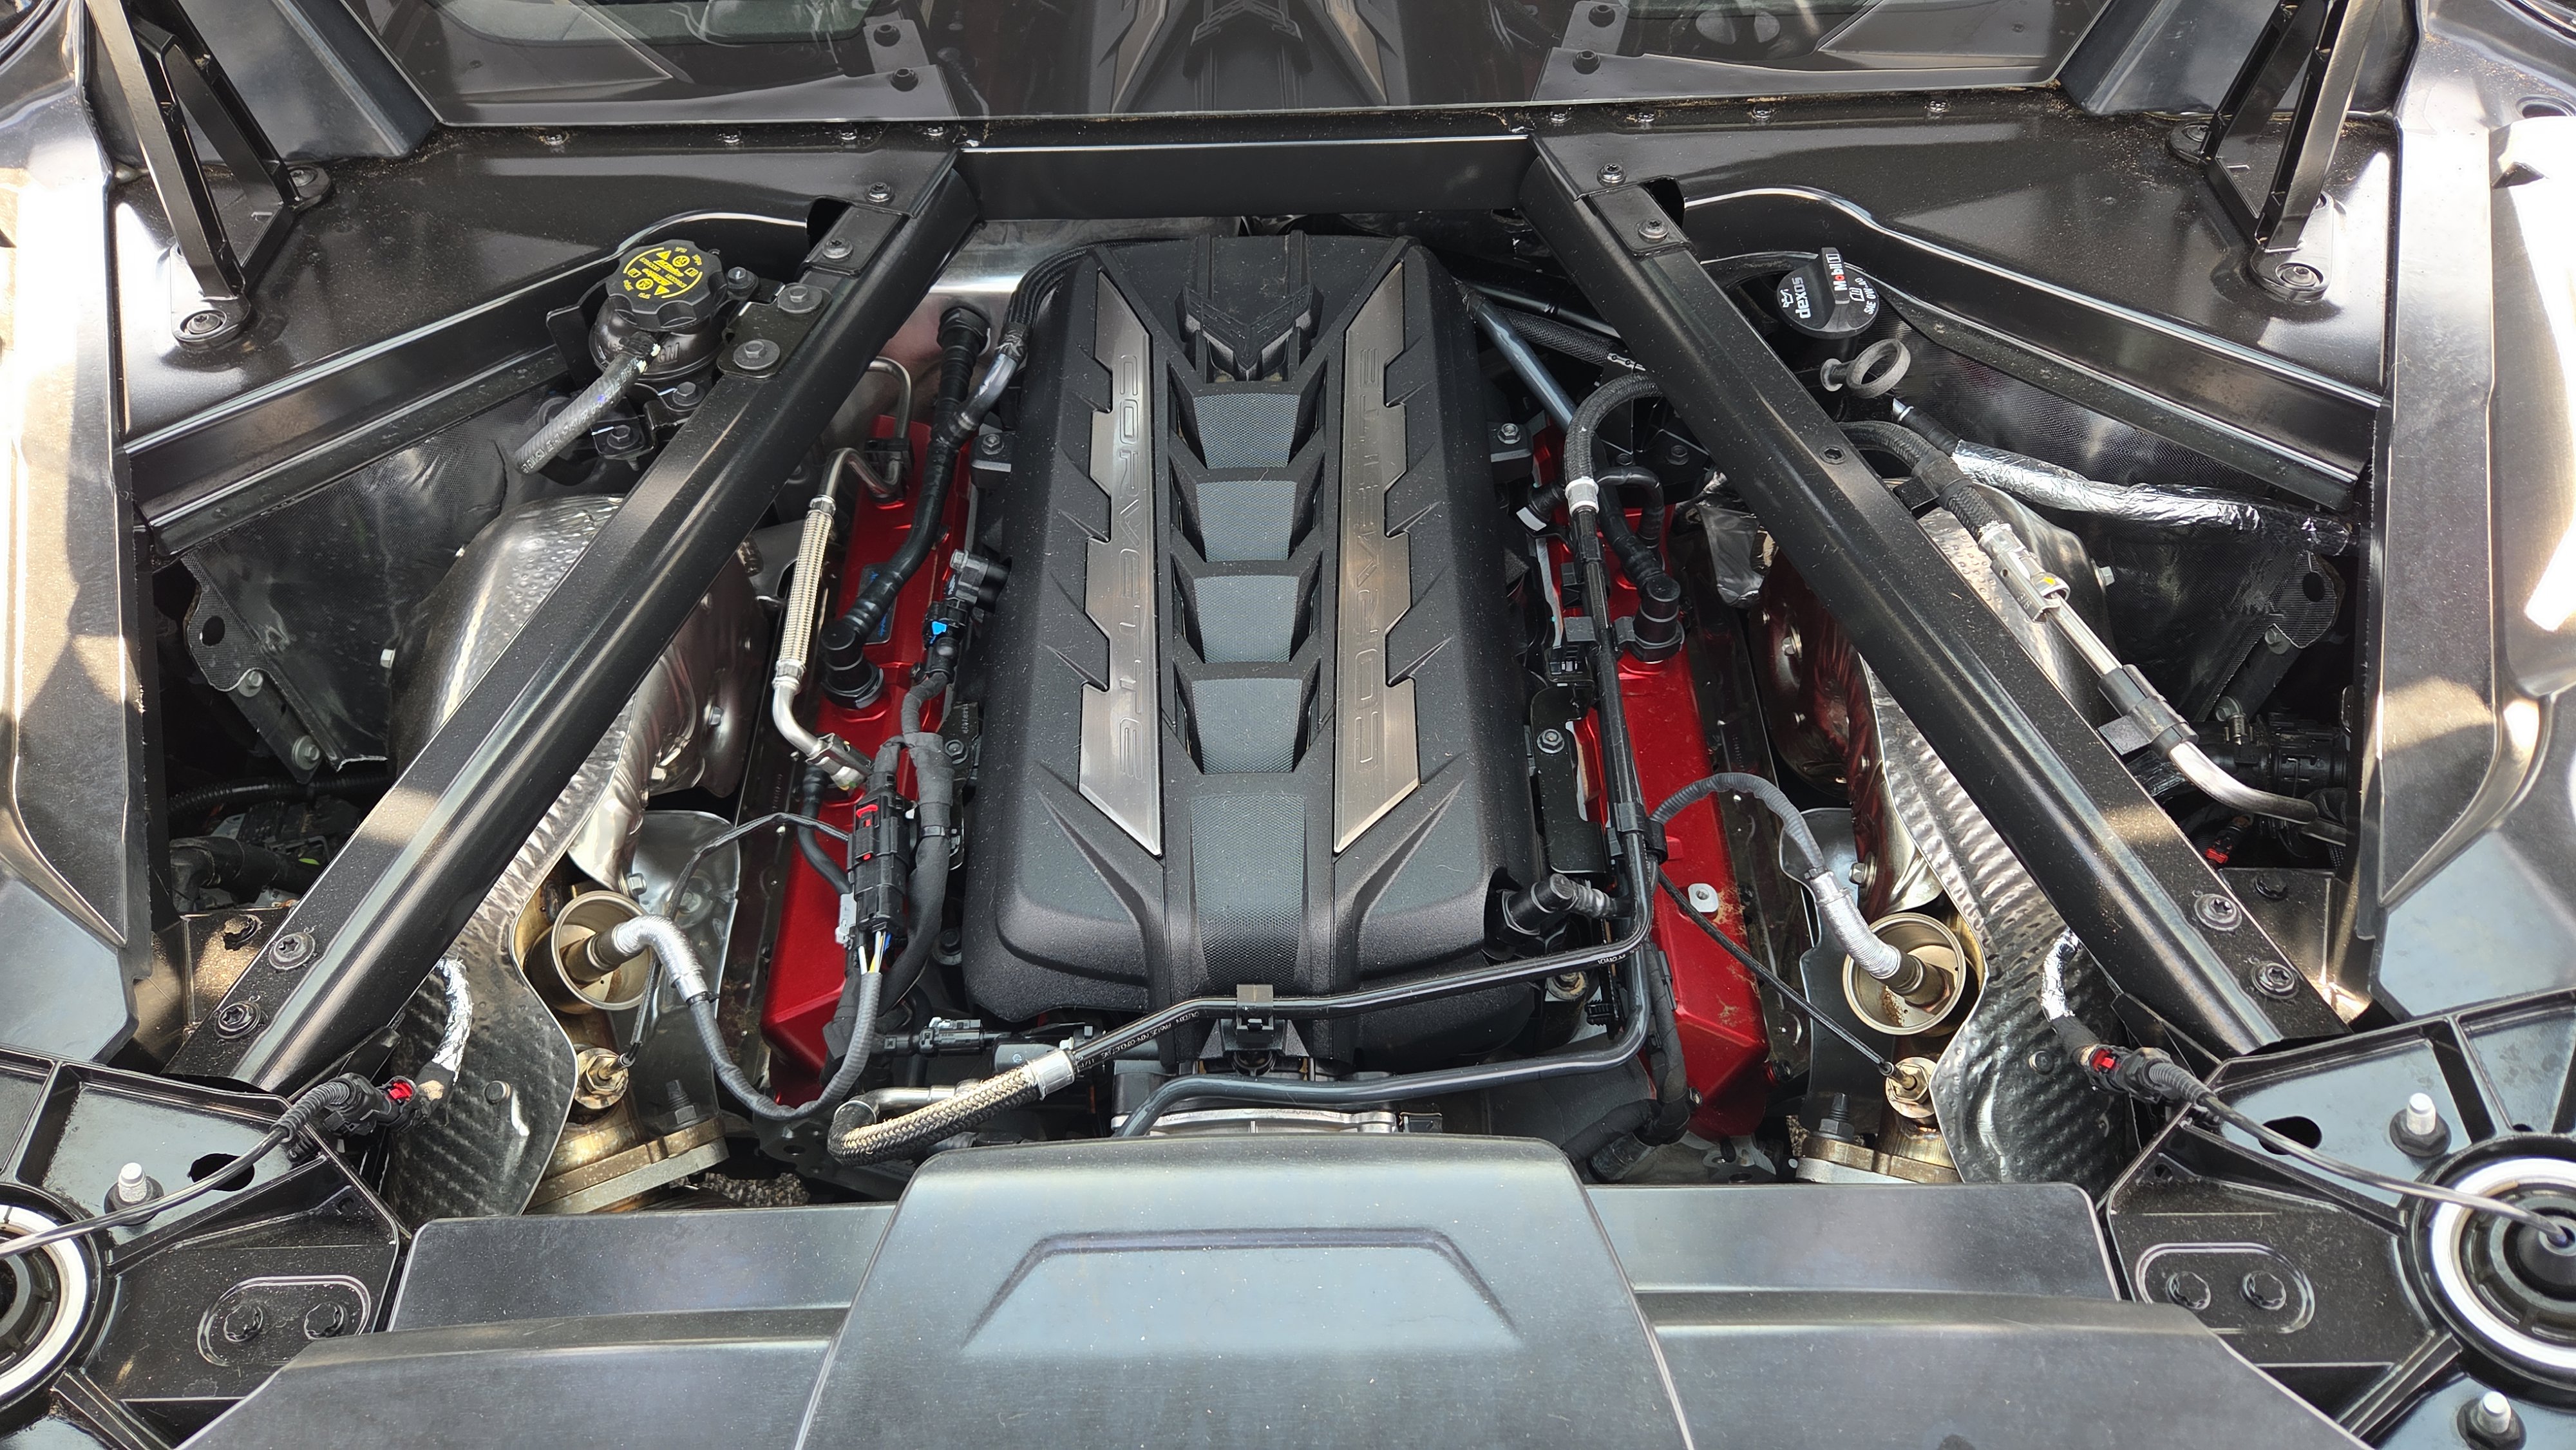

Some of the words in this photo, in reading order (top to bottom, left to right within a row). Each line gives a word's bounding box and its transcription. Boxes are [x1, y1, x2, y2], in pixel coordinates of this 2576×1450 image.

[1829, 263, 1848, 291] Mobil
[1854, 278, 1877, 299] 0W-40
[1791, 277, 1812, 319] dexos
[1864, 301, 1877, 314] SAE
[659, 342, 680, 364] GM
[1118, 353, 1144, 780] CORVETTE
[1353, 348, 1379, 775] CORVETTE
[2017, 592, 2032, 610] 3/8
